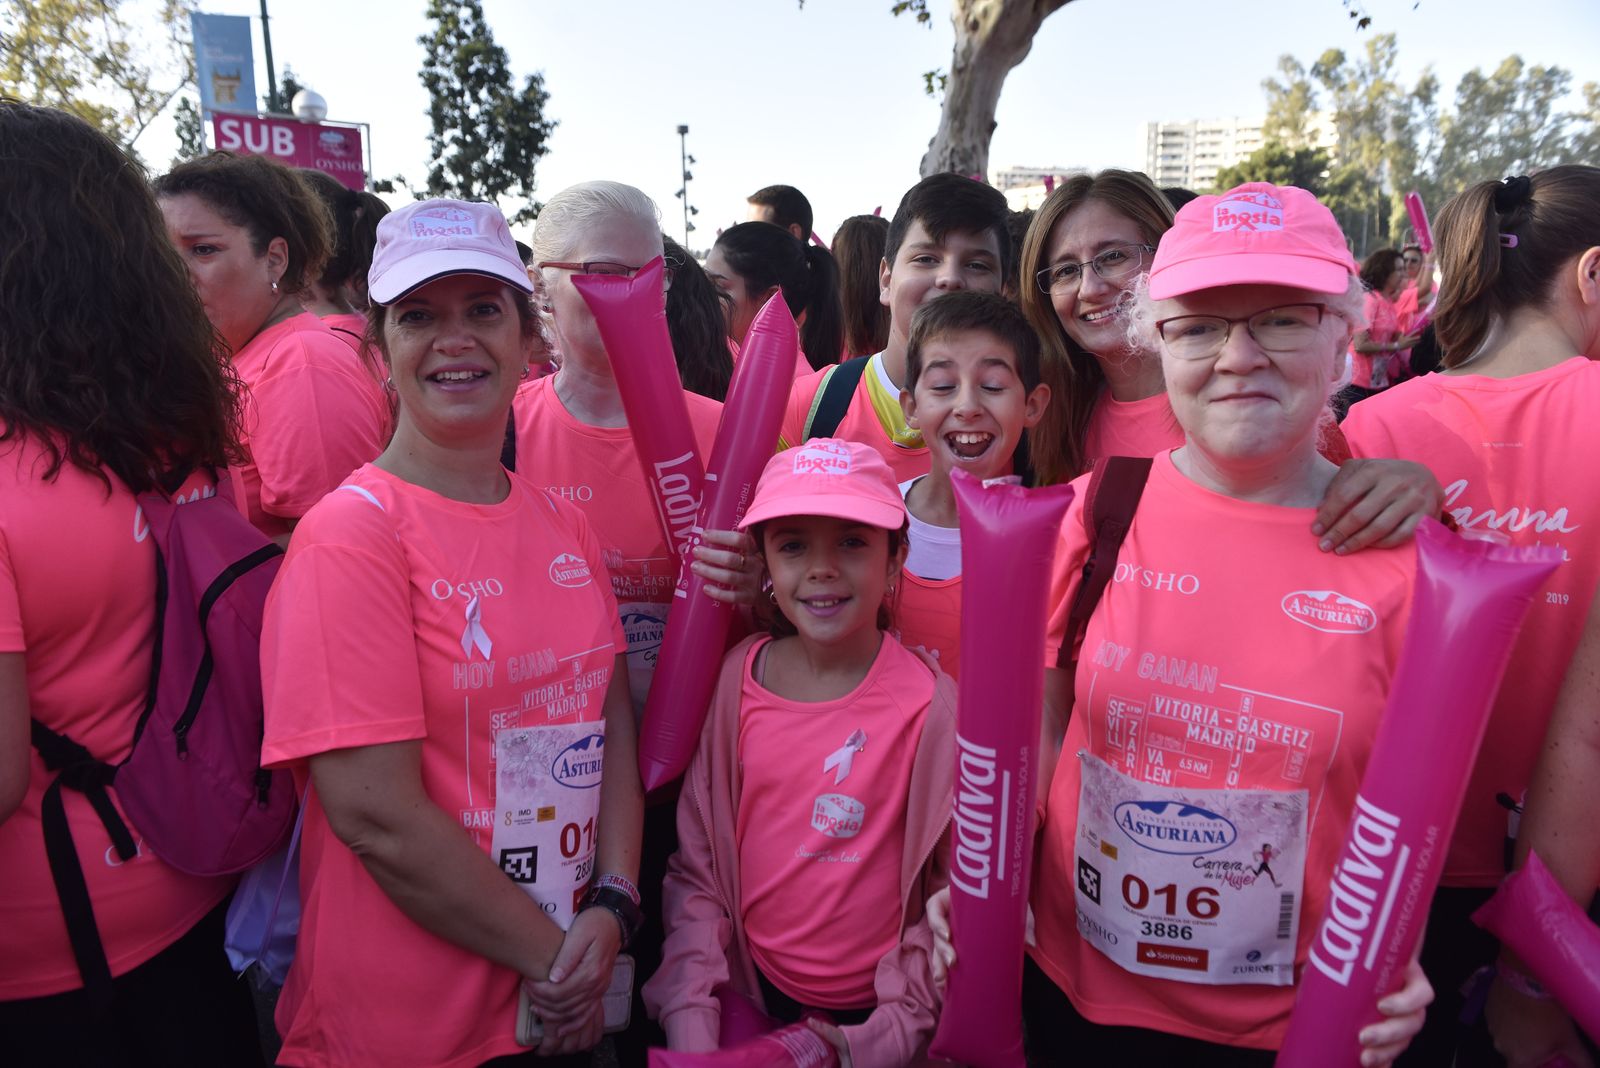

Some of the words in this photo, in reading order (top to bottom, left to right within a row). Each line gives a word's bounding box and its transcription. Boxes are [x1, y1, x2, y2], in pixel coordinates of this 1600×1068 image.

[220, 120, 295, 156] SUB
[1113, 562, 1200, 595] OYSHO
[1288, 598, 1369, 628] ASTURIANA
[1546, 592, 1569, 605] 2019
[453, 661, 496, 690] HOY
[507, 647, 559, 684] GANAN
[1137, 652, 1219, 693] GANAN
[523, 682, 565, 710] VITORIA
[547, 693, 589, 719] MADRID
[1155, 696, 1219, 727] VITORIA
[1238, 715, 1310, 749] GASTEIZ
[1186, 722, 1257, 753] MADRID
[518, 809, 532, 817] IMD
[950, 732, 997, 900] Ladival
[1121, 809, 1228, 845] ASTURIANA
[560, 817, 597, 858] 01
[1121, 873, 1221, 920] 016
[1204, 871, 1213, 879] de
[1221, 870, 1257, 890] Mujer
[1309, 793, 1401, 987] Ladival
[1078, 910, 1119, 945] OYSHO
[1140, 920, 1193, 940] 3886
[1156, 952, 1200, 964] Santander
